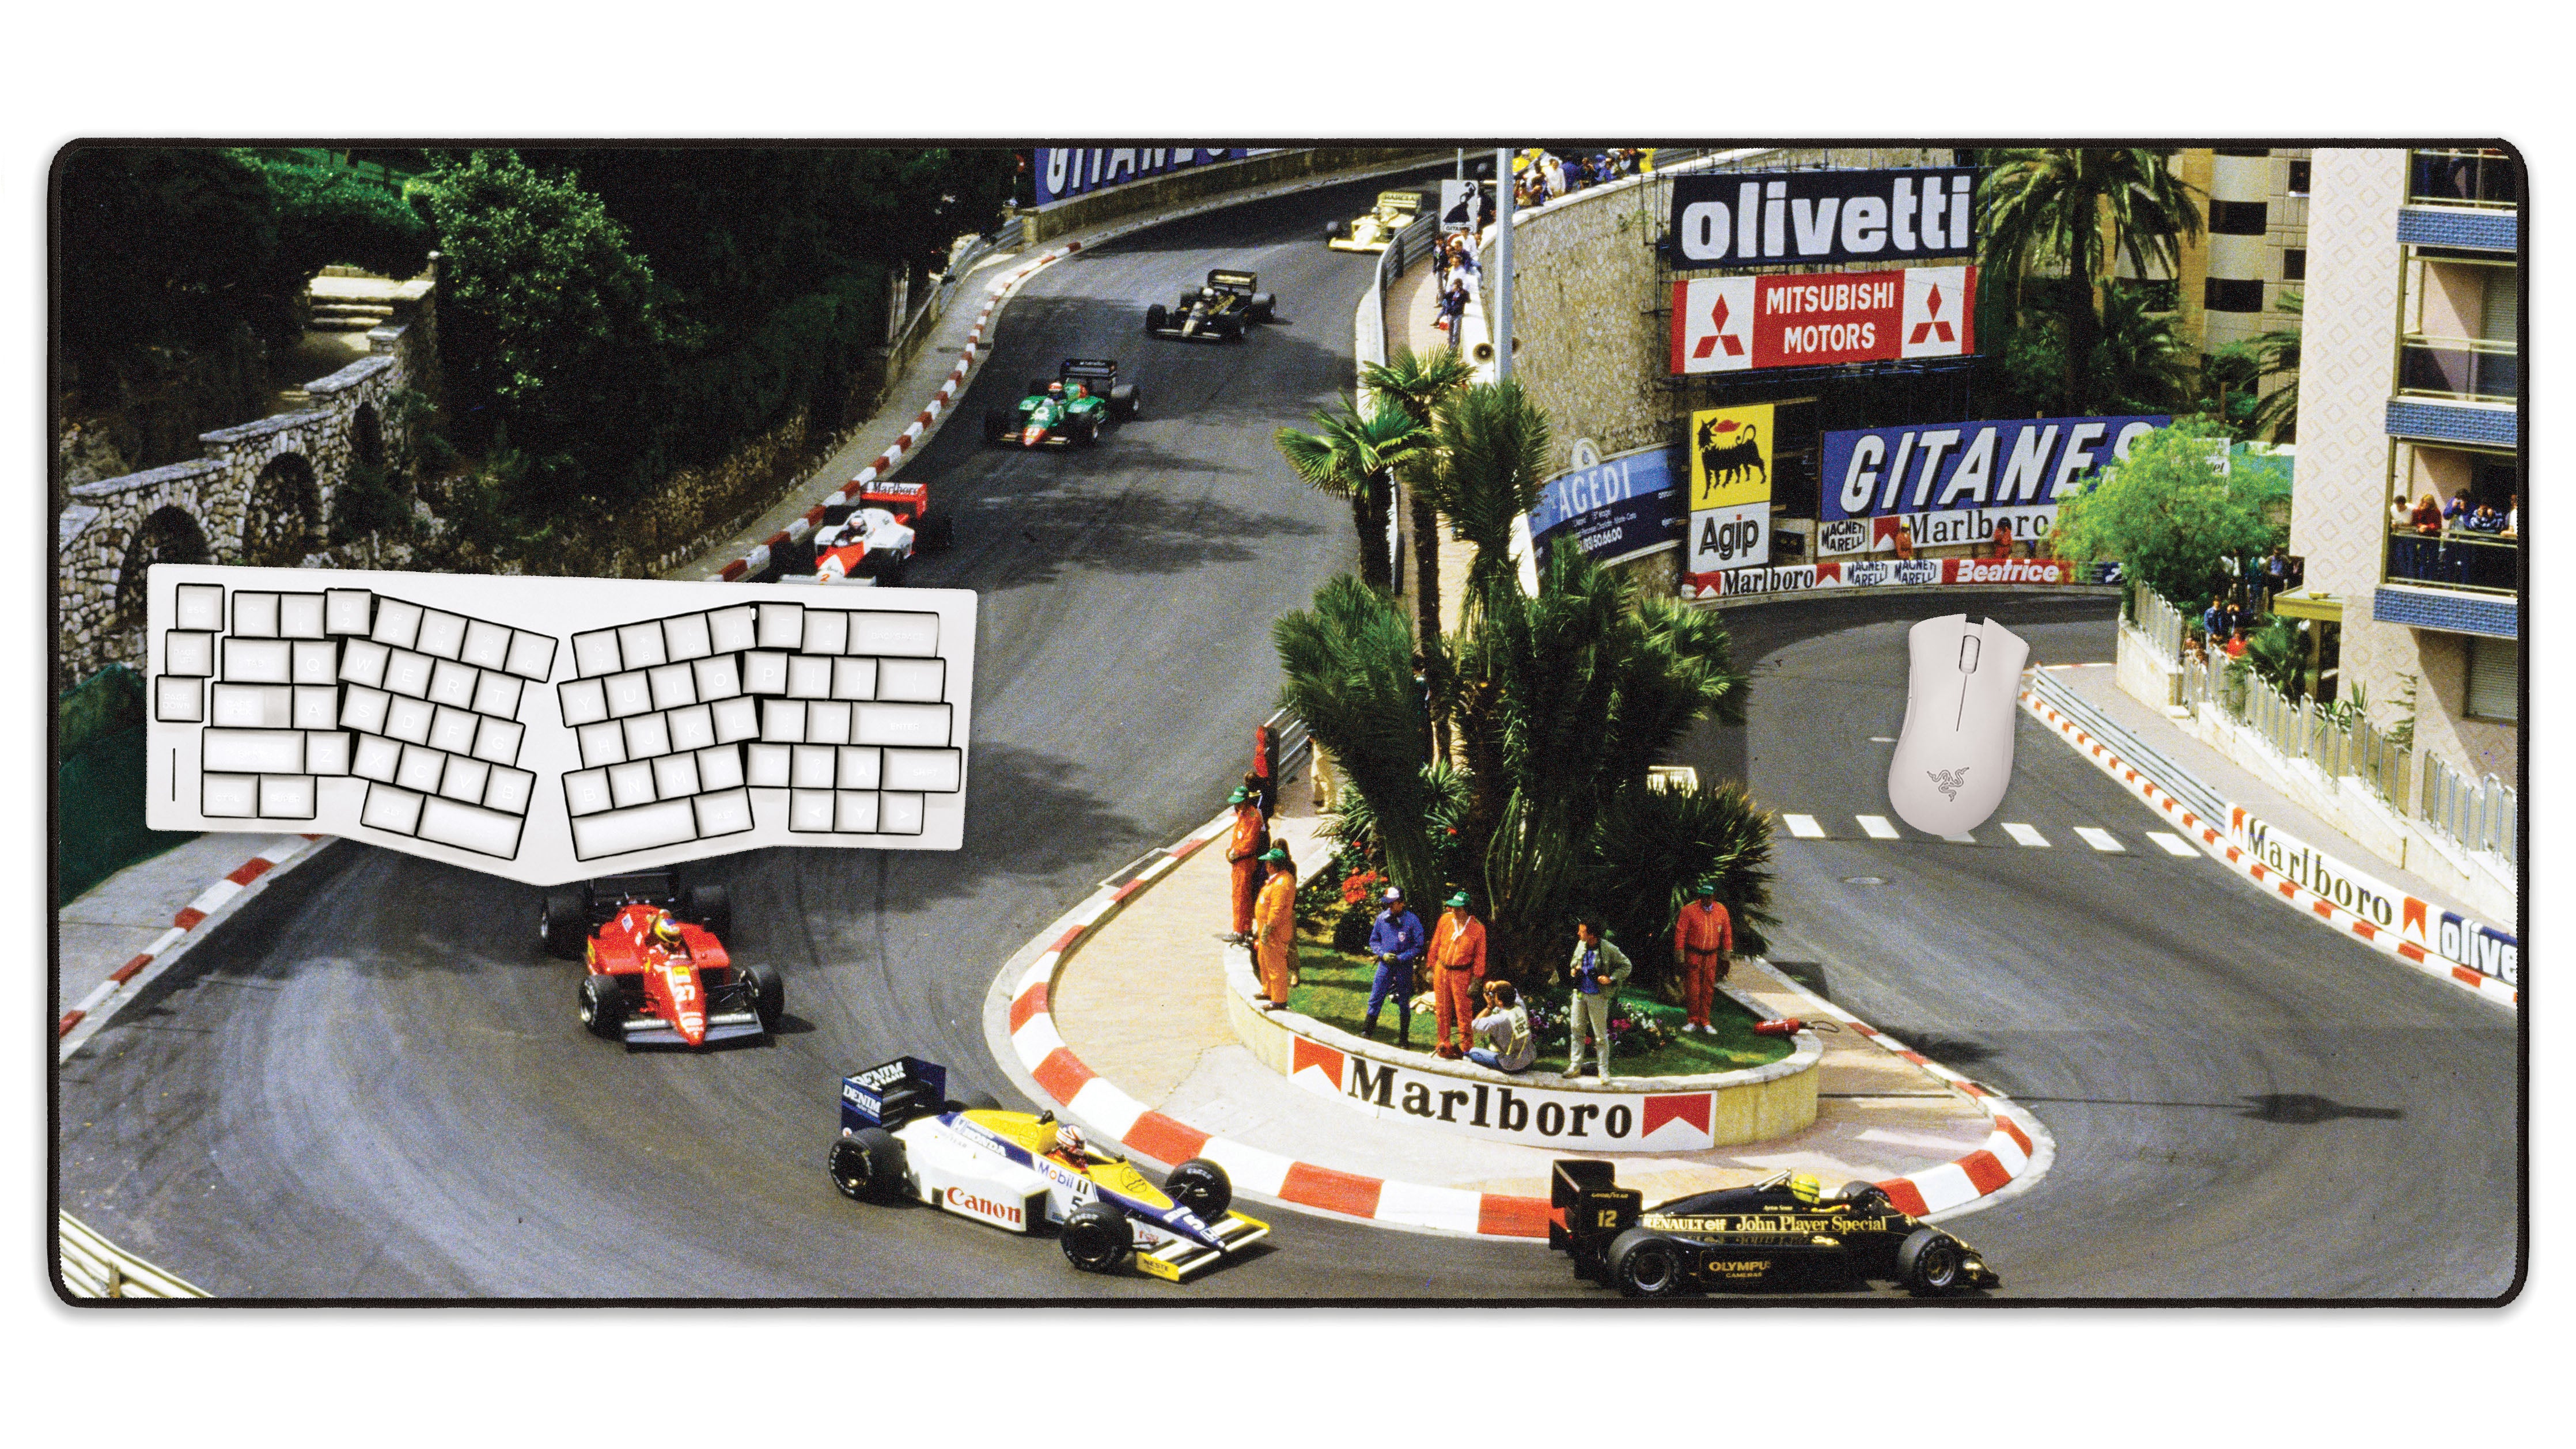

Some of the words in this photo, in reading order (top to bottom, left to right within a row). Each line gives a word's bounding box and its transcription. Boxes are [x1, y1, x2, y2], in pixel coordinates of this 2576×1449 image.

[1681, 176, 1971, 260] olivetti
[1766, 282, 1895, 314] MITSUBISHI
[1784, 321, 1876, 354] MOTORS
[1560, 462, 1631, 521] AGEDI
[1698, 514, 1759, 561] Agip
[1956, 559, 2059, 582] Beatrice
[820, 574, 830, 582] 2
[1722, 565, 1814, 595] Marlboro
[187, 606, 207, 614] ESC
[342, 618, 351, 627] 2
[870, 632, 925, 641] BACKSPACE
[435, 640, 444, 650] 4
[688, 643, 696, 652] 9
[173, 648, 196, 657] PAGE
[479, 651, 489, 661] 5
[642, 651, 650, 661] 8
[245, 659, 264, 668] TAB
[306, 658, 320, 672] Q
[357, 657, 372, 672] W
[525, 660, 533, 670] 6
[402, 669, 415, 682] E
[714, 673, 727, 687] O
[763, 667, 775, 682] P
[447, 678, 460, 694] R
[164, 693, 188, 701] PAGE
[493, 689, 506, 704] T
[623, 689, 637, 703] U
[162, 701, 190, 710] DOWN
[307, 703, 321, 716] A
[578, 696, 591, 711] Y
[357, 704, 370, 718] S
[403, 715, 415, 729] D
[732, 715, 744, 729] L
[890, 722, 920, 731] ENTER
[447, 725, 459, 738] F
[687, 723, 700, 737] K
[493, 737, 505, 750] G
[644, 730, 655, 745] J
[598, 739, 611, 754] H
[319, 749, 333, 763] Z
[369, 753, 384, 768] X
[414, 764, 427, 778] C
[912, 768, 938, 777] SHIFT
[460, 774, 473, 789] V
[672, 771, 687, 787] M
[502, 784, 514, 800] B
[627, 779, 641, 795] N
[584, 788, 597, 802] B
[2247, 818, 2393, 927] Marlboro
[675, 985, 695, 1002] 27
[851, 1061, 904, 1088] DENIM
[843, 1084, 882, 1113] DENIM
[1347, 1056, 1632, 1139] Marlboro
[1038, 1161, 1074, 1189] Mobil
[947, 1186, 1022, 1224] Canon
[1070, 1195, 1084, 1213] 5
[1183, 1214, 1206, 1231] 5
[1598, 1210, 1617, 1228] 12
[1643, 1218, 1704, 1230] RENAULT
[1704, 1219, 1727, 1231] elf
[1736, 1216, 1775, 1231] John
[1779, 1215, 1829, 1234] Player
[1832, 1216, 1887, 1234] Special
